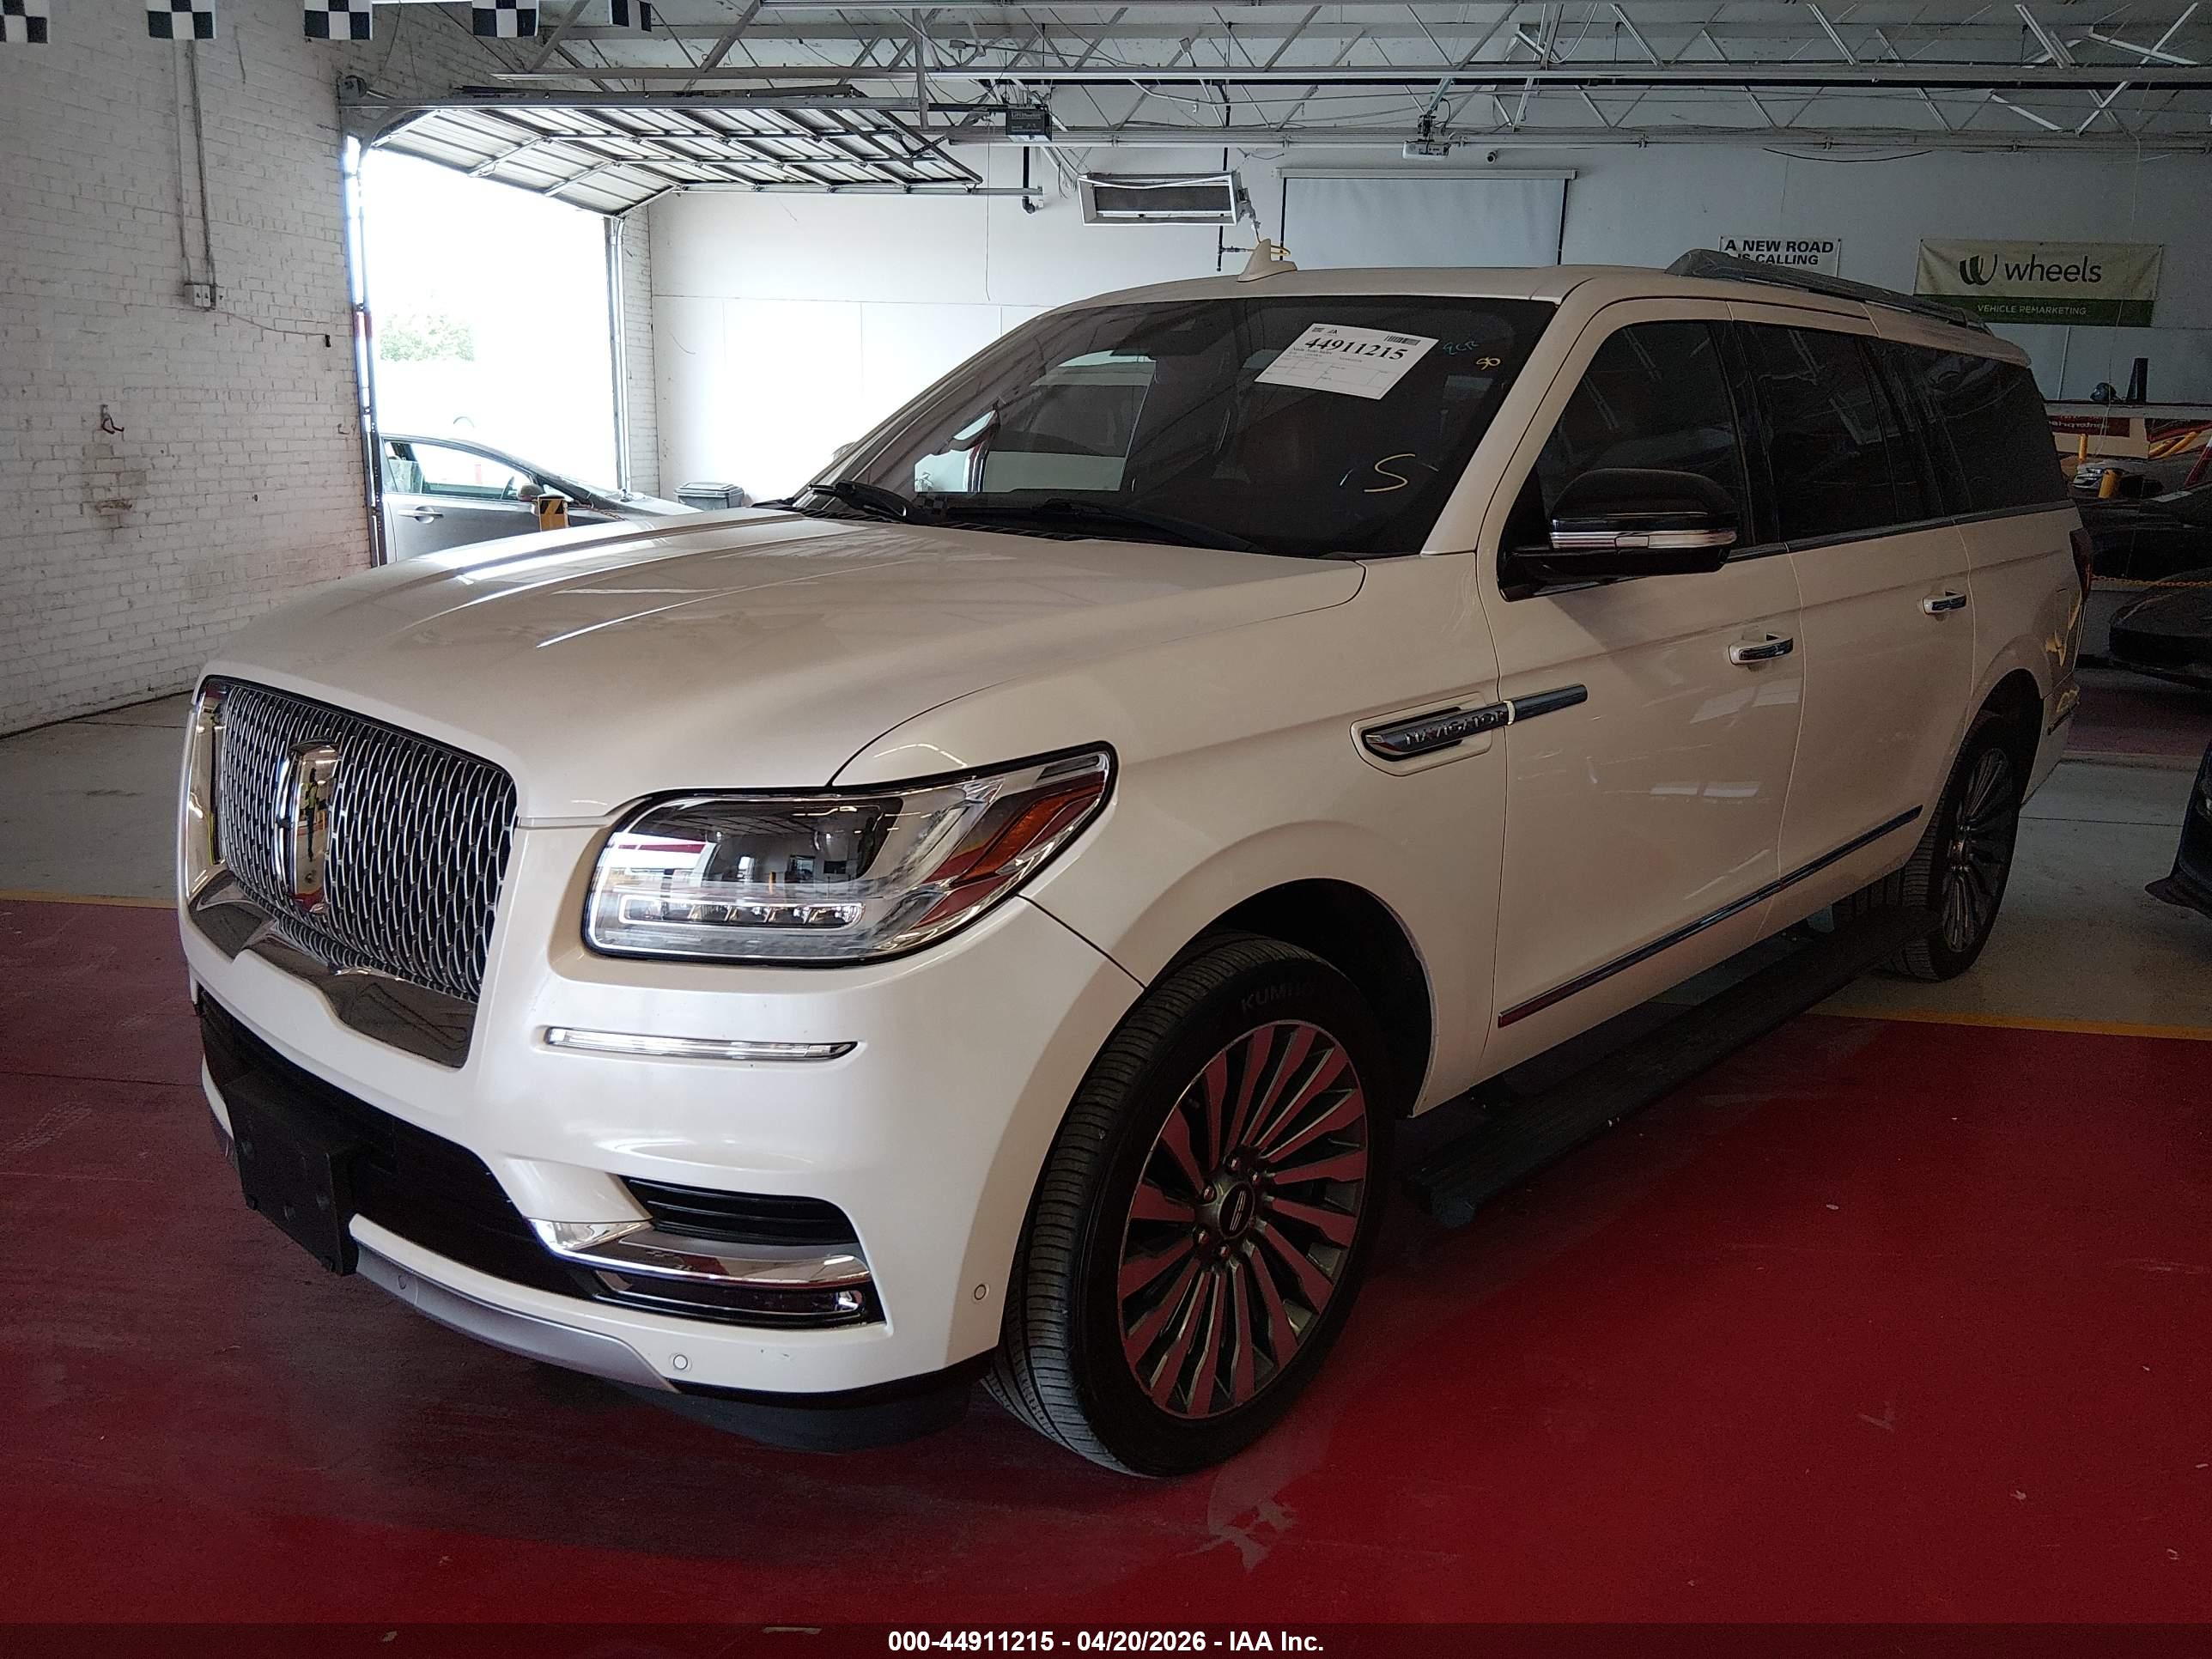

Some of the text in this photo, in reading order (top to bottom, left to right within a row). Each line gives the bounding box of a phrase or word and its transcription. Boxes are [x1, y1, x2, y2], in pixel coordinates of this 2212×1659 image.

[1725, 240, 1833, 252] A NEW ROAD
[1756, 254, 1819, 264] CALLING
[2005, 254, 2101, 283] wheels
[1978, 304, 2087, 316] VEHICLE REMARKETING
[1304, 337, 1409, 361] 44911215
[1364, 453, 1416, 493] S
